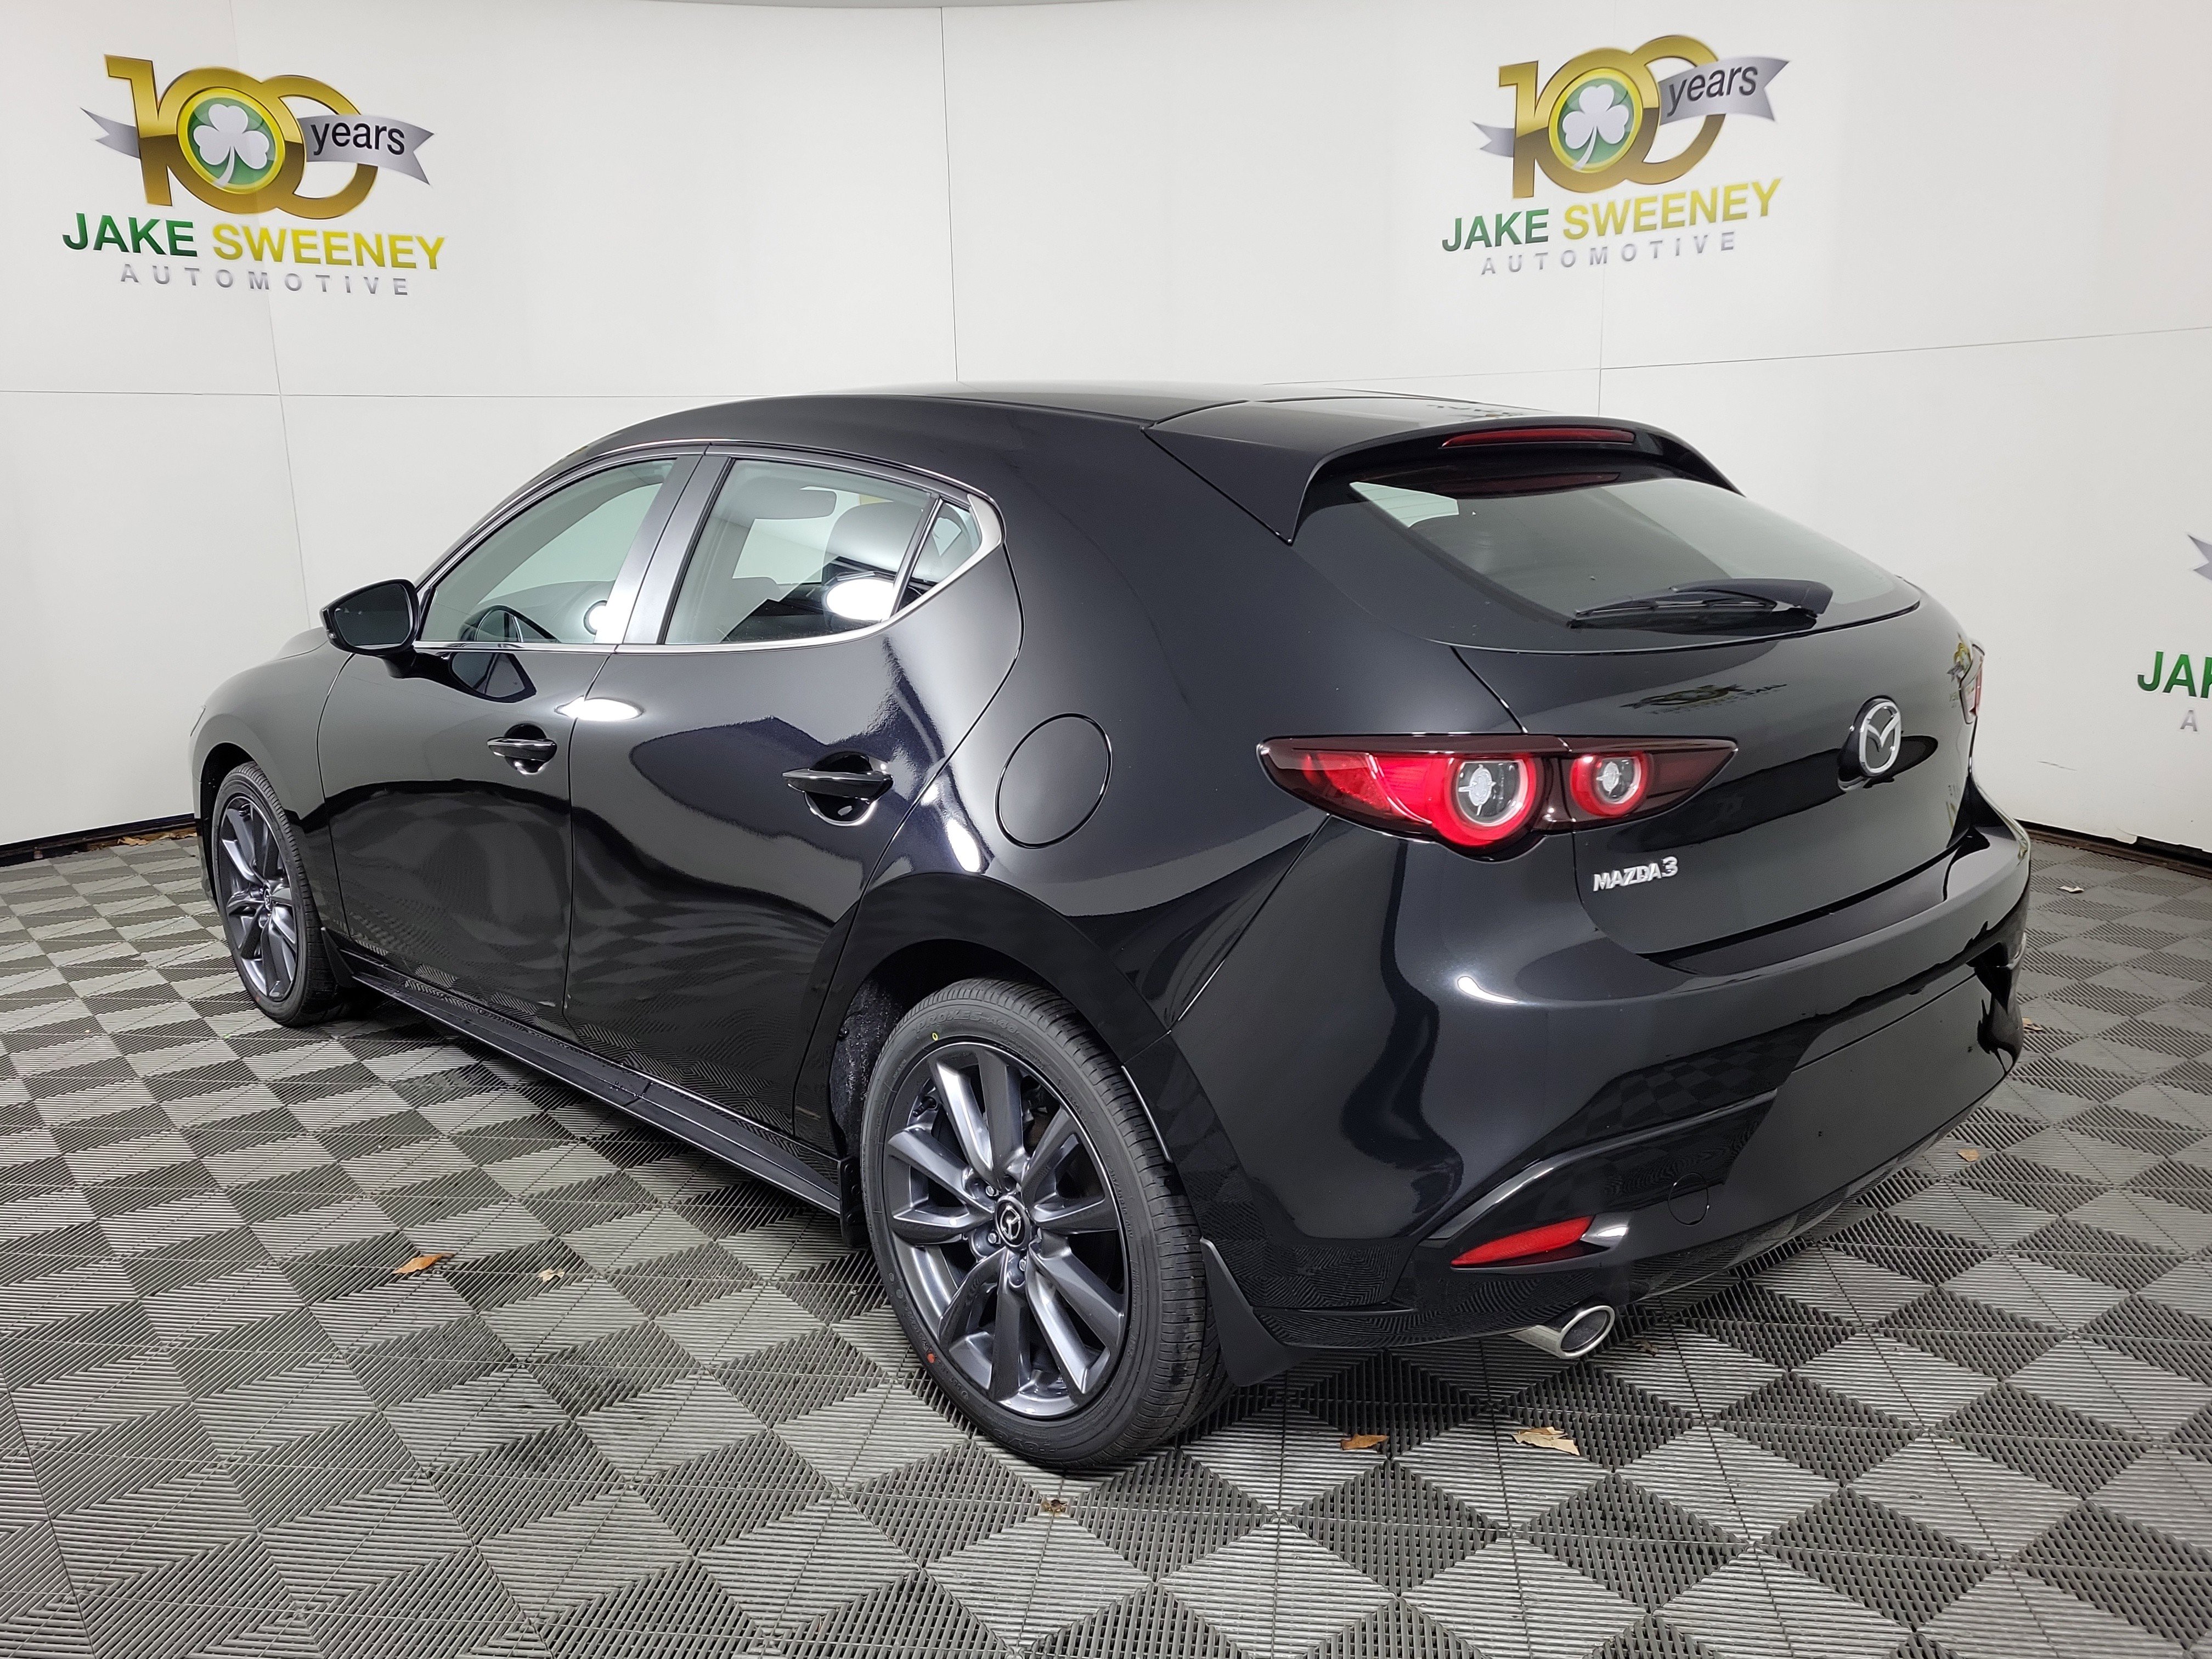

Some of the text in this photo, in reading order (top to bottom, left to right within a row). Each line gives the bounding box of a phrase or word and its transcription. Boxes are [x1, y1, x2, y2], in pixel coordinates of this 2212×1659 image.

[1667, 64, 1758, 117] years
[311, 121, 406, 156] years
[1441, 178, 1781, 252] JAKE SWEENEY
[62, 212, 445, 270] JAKE SWEENEY
[1481, 231, 1735, 276] AUTOMOTIVE
[120, 263, 409, 296] AUTOMOTIVE
[1593, 856, 1678, 891] MAZDA3
